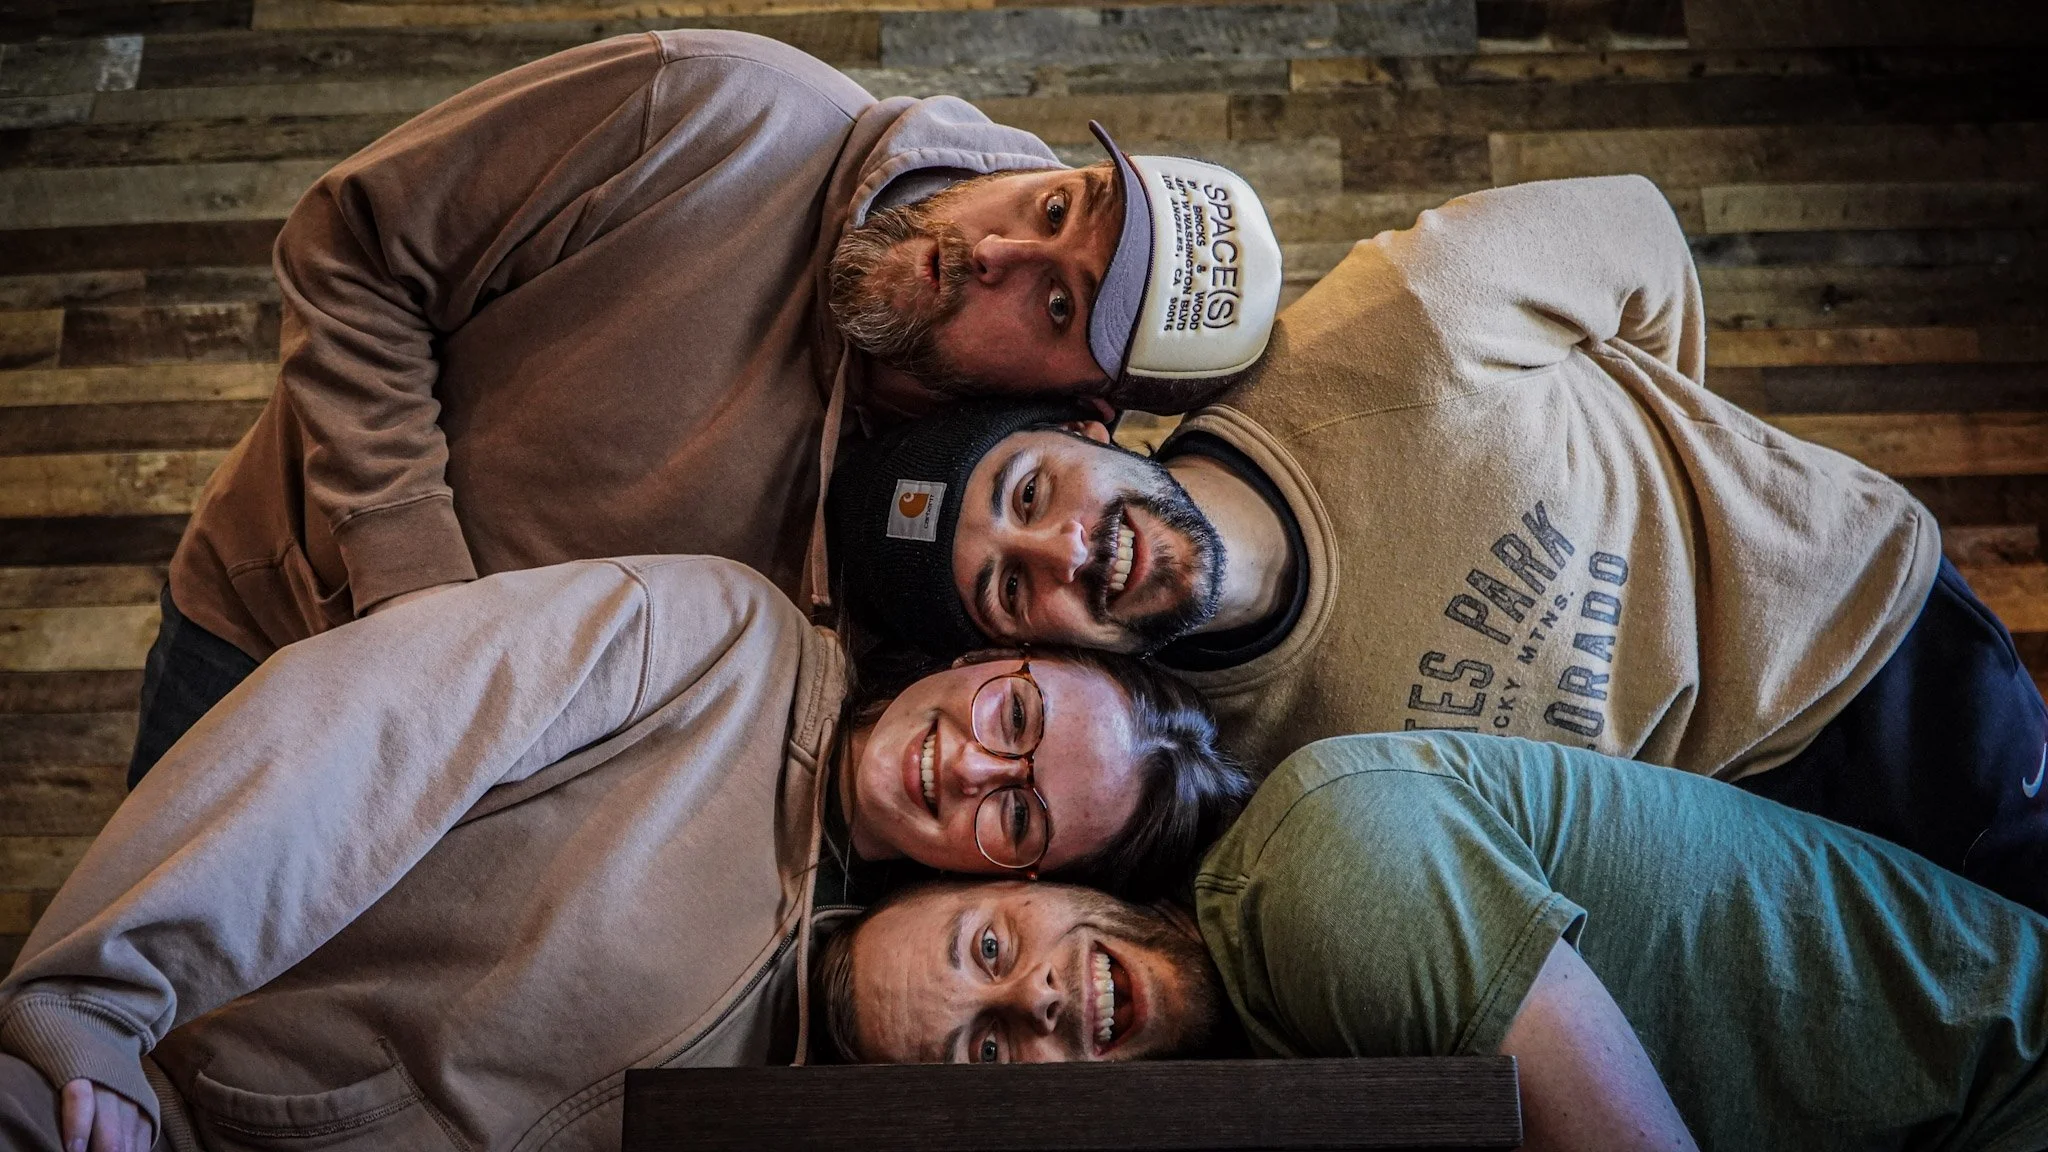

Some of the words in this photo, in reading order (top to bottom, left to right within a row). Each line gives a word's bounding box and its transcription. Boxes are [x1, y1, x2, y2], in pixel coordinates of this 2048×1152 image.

[1162, 175, 1175, 190] LOS
[1181, 201, 1191, 211] W
[1193, 205, 1206, 247] BRICKS
[1182, 213, 1194, 295] WASHINGTON
[1196, 265, 1207, 273] &
[1203, 185, 1239, 329] SPACE(S)
[1173, 268, 1183, 286] CA
[1164, 296, 1178, 331] 90016
[1177, 300, 1190, 331] BLVD
[1189, 291, 1206, 330] WOOD
[1444, 500, 1576, 646] PARK
[1493, 677, 1521, 737] CKY
[1517, 591, 1575, 665] MTNS.
[1543, 551, 1629, 750] ORADO
